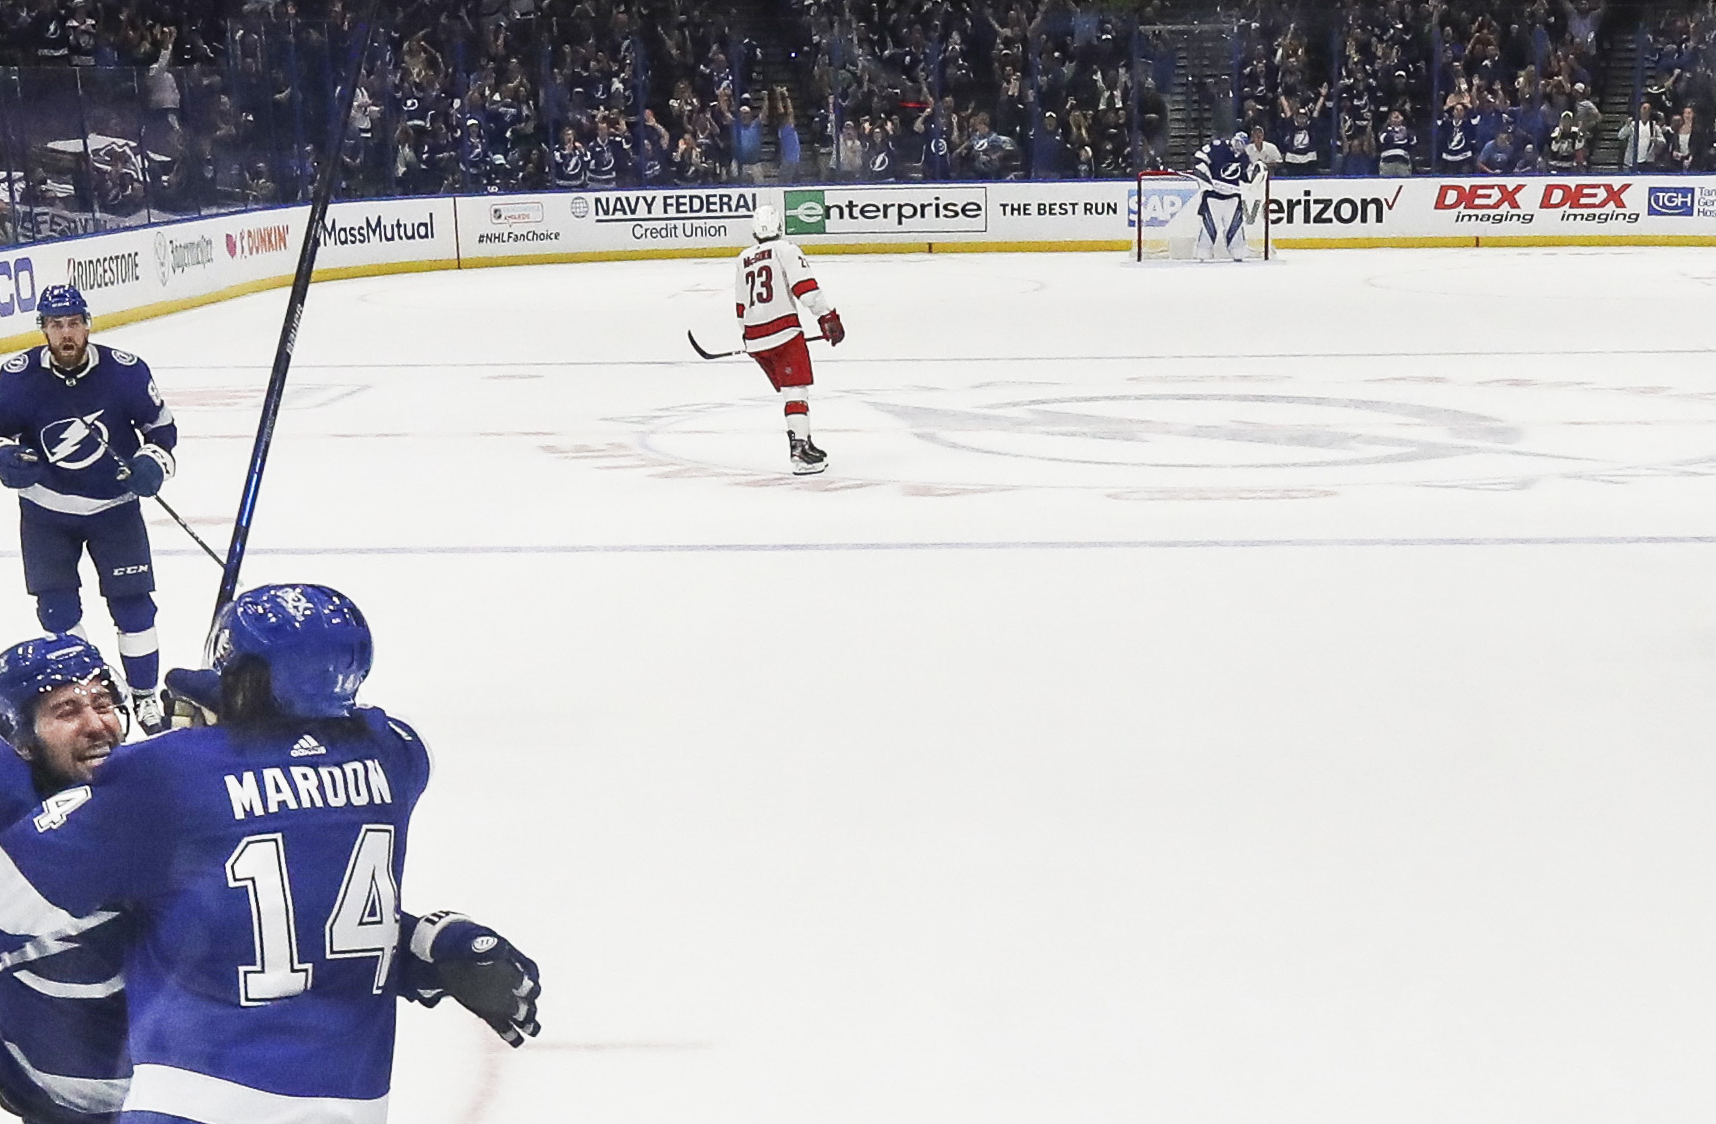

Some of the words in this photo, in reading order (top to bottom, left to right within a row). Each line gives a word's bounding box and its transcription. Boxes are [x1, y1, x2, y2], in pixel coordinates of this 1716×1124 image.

[595, 196, 656, 215] NAVY
[1128, 193, 1183, 219] SAP
[1434, 184, 1527, 209] DEX
[1539, 183, 1632, 208] DEX
[1656, 192, 1691, 206] TGH
[797, 196, 983, 226] enterprise
[999, 202, 1029, 217] THE
[1037, 203, 1077, 216] BEST
[1084, 202, 1117, 215] RUN
[1455, 211, 1534, 225] imaging
[1560, 210, 1640, 224] imaging
[247, 225, 289, 256] DUNKIN'
[322, 212, 435, 247] MassMutual
[478, 230, 561, 244] #NHLFanChoice
[632, 223, 678, 240] Credit
[683, 221, 727, 237] Union
[66, 251, 140, 297] BRIDGESTONE
[224, 759, 392, 820] MAROON
[33, 785, 92, 833] 4
[224, 824, 400, 1007] 14
